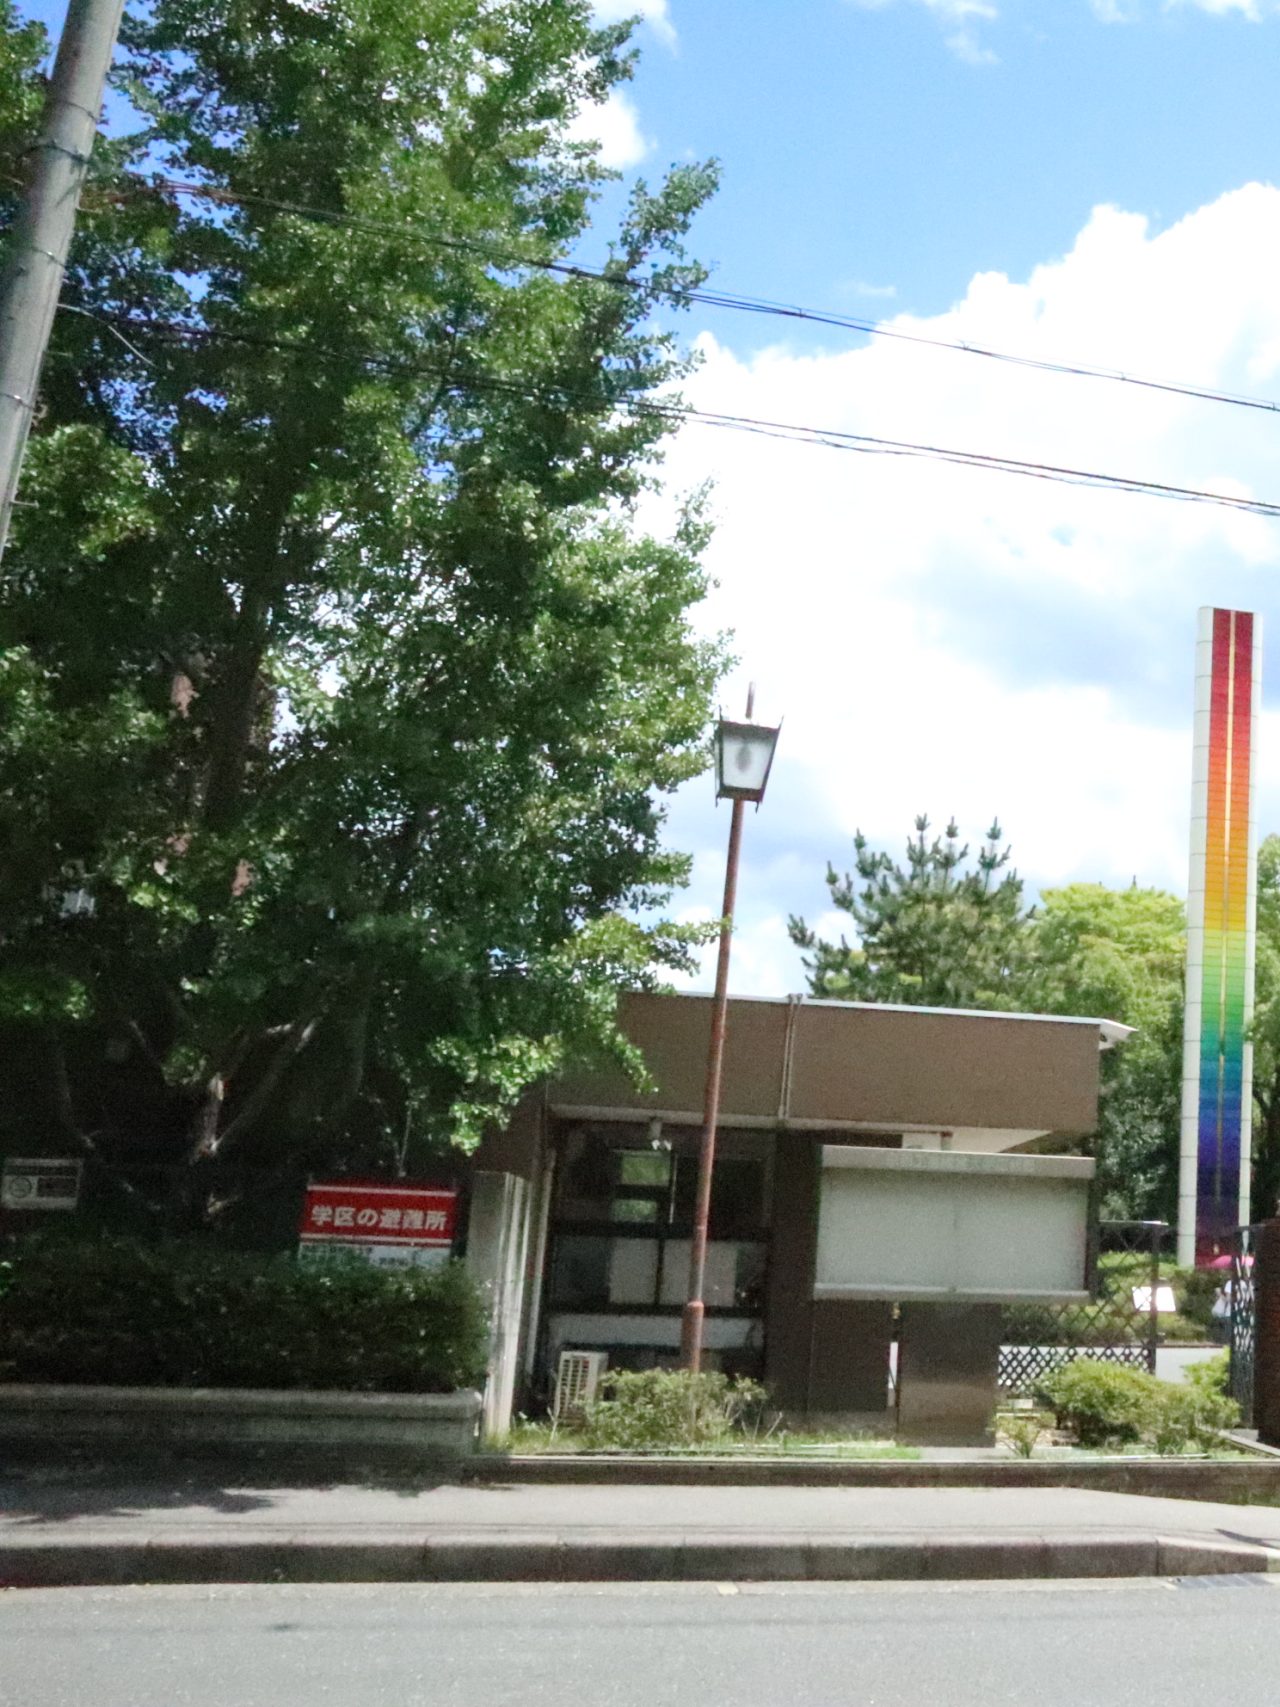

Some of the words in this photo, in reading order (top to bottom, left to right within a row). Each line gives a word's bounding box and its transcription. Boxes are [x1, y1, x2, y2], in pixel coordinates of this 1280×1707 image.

[311, 1205, 447, 1231] 学区の避難所
